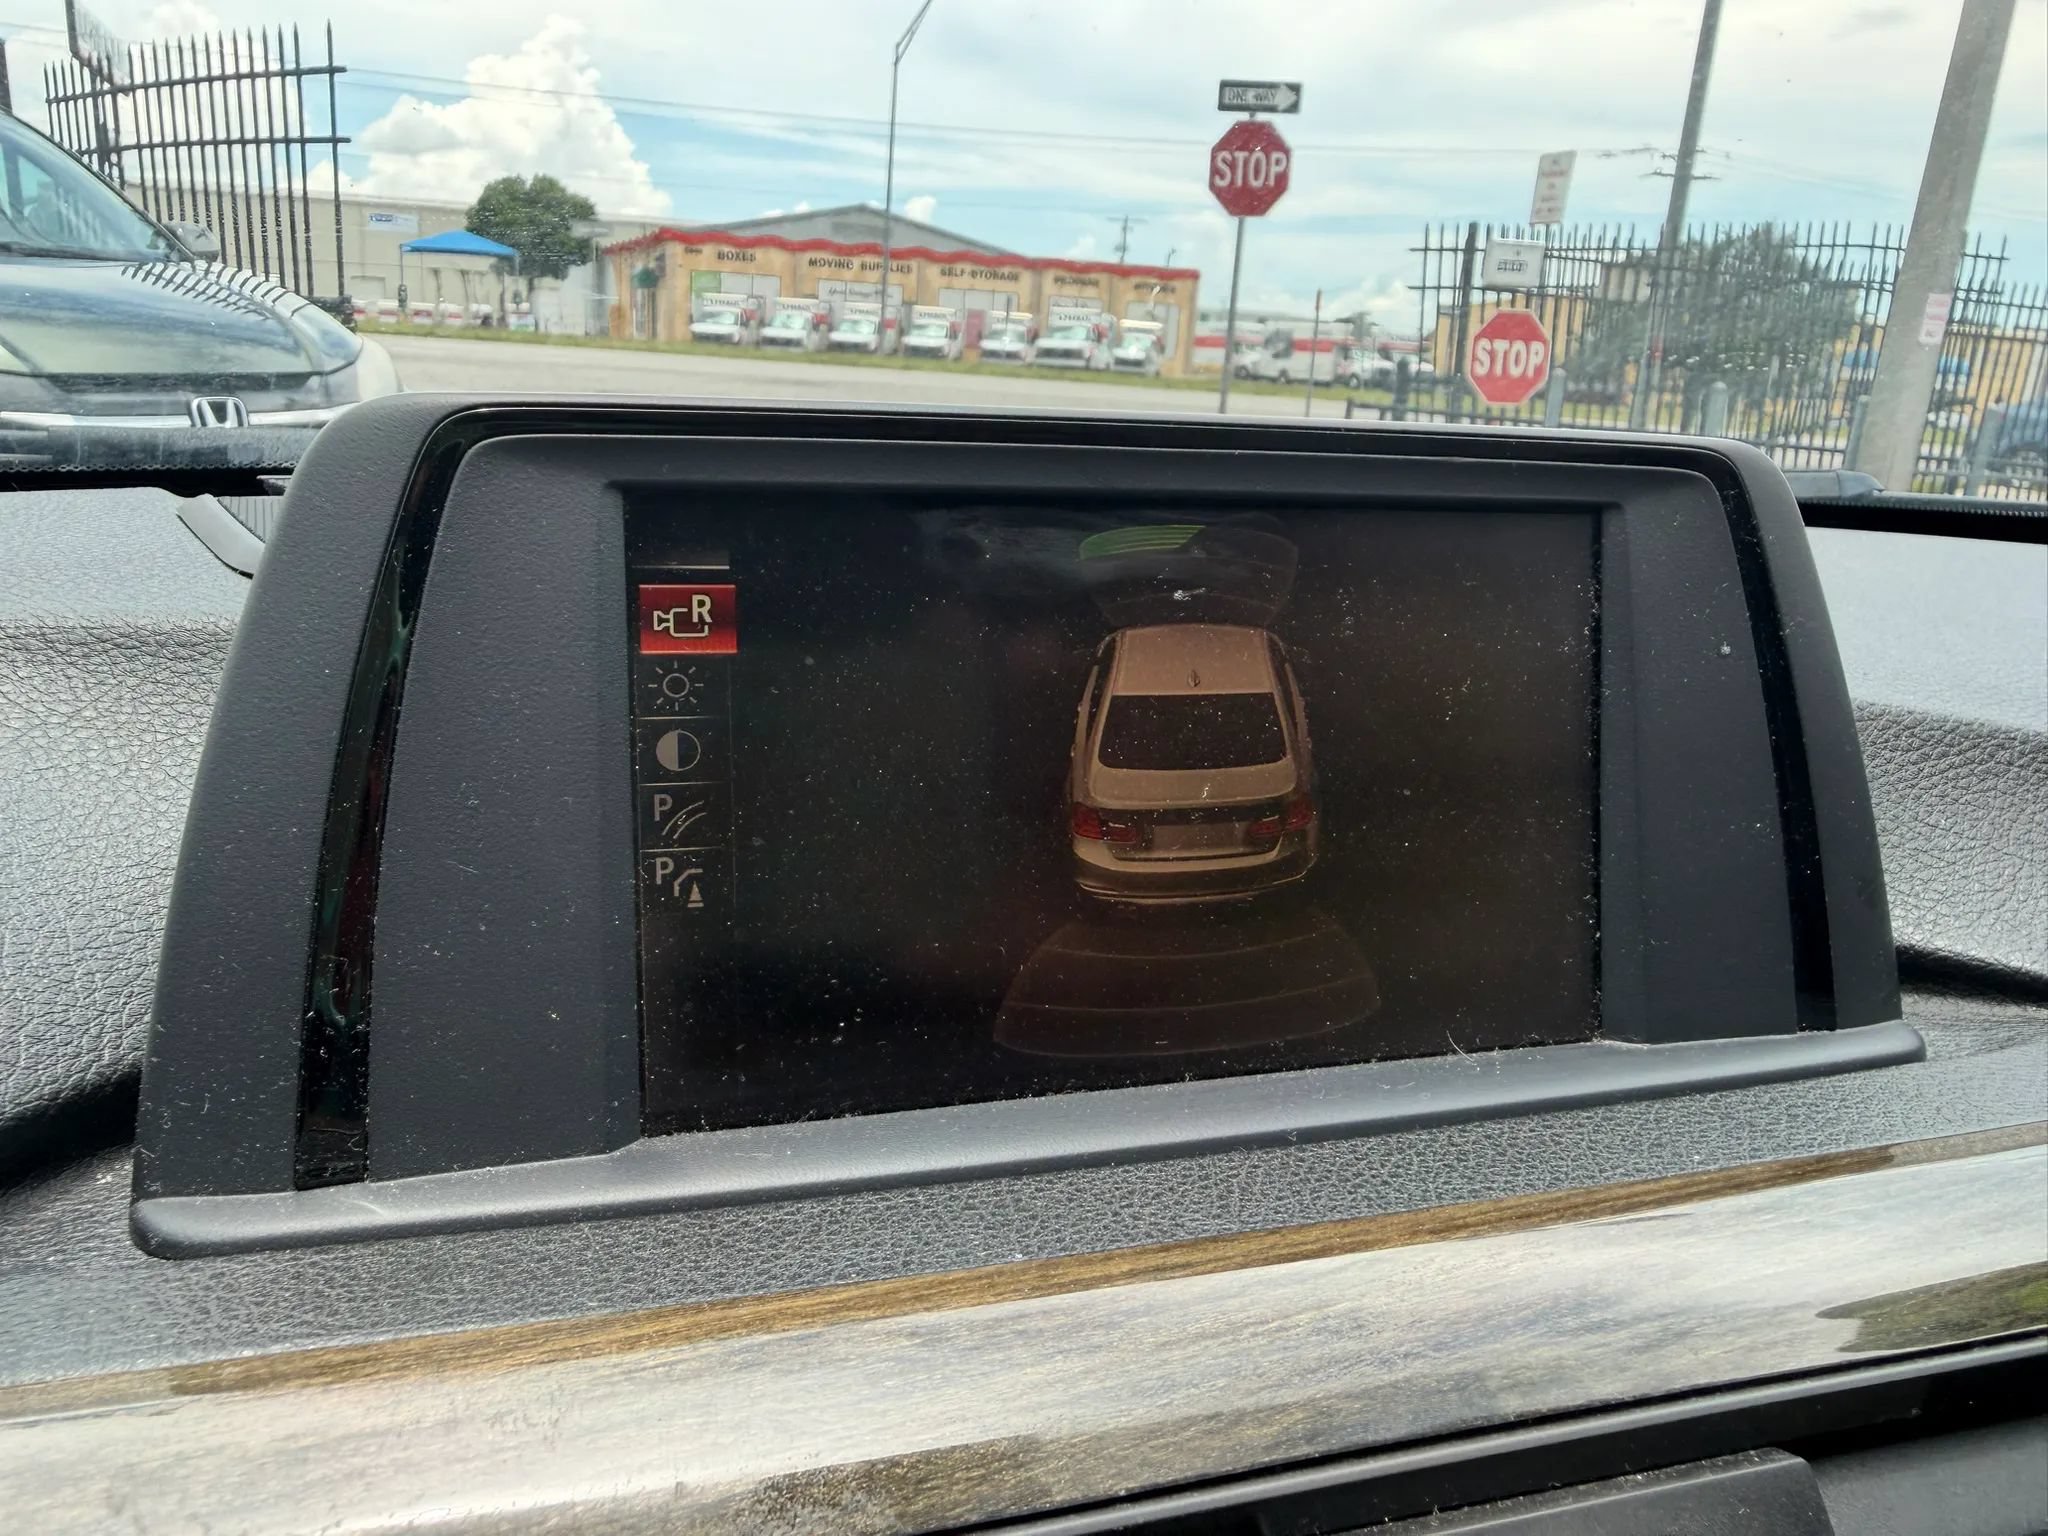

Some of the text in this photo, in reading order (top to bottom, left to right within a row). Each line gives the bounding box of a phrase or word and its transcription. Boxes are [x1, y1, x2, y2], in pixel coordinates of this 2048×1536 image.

[1213, 150, 1288, 188] STOP
[717, 249, 757, 262] BOXES
[808, 257, 913, 274] MOVING SUPLIES
[1473, 338, 1545, 377] STOP
[691, 594, 713, 624] R
[653, 794, 673, 822] P
[655, 857, 675, 885] P
